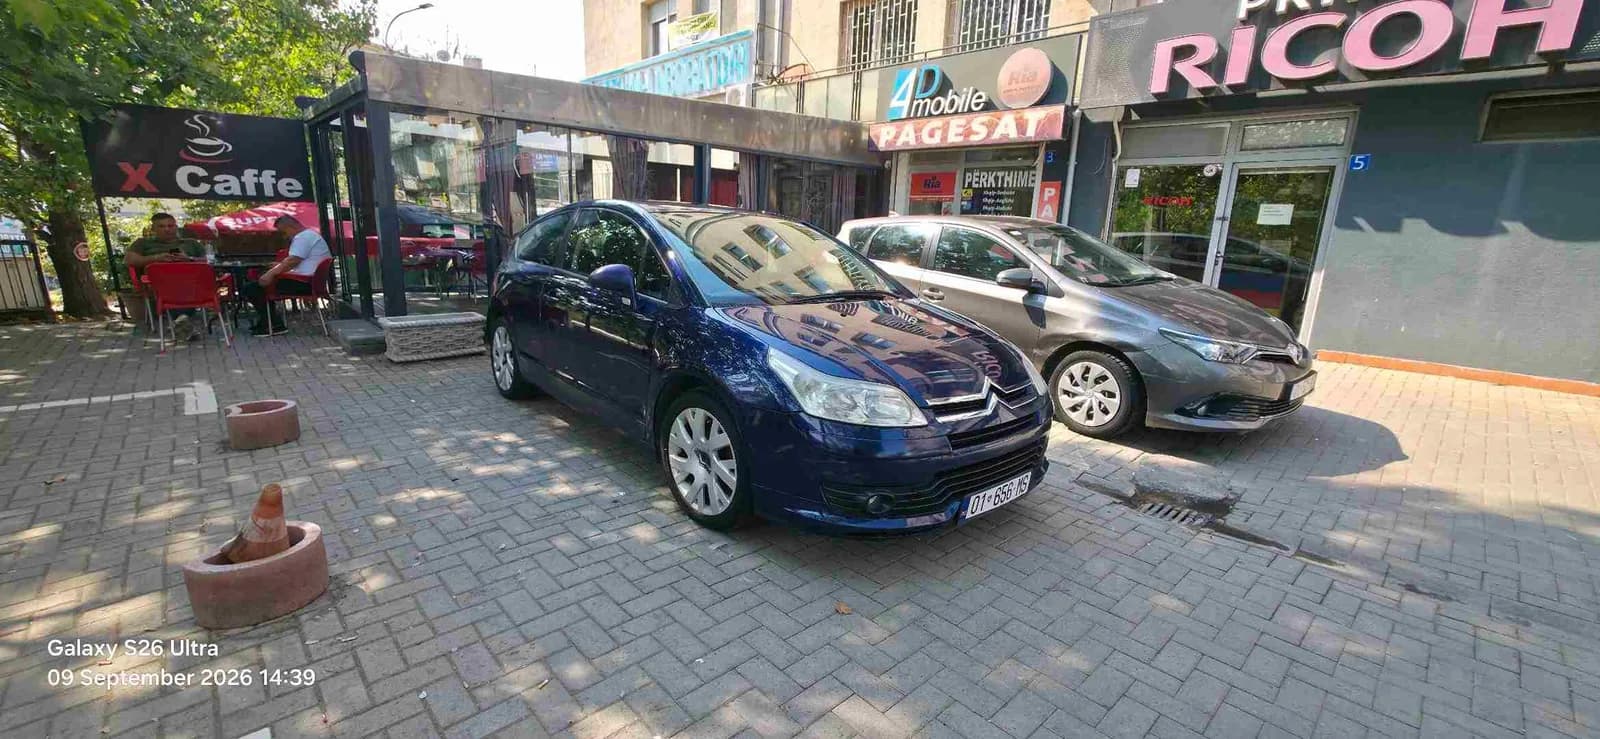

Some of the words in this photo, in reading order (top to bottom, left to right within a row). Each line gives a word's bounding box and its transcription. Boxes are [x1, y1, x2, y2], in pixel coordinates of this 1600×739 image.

[1149, 0, 1583, 95] RICOH
[911, 86, 986, 118] mobile
[878, 110, 1047, 148] PAGESAT
[1046, 152, 1054, 163] 3
[1352, 155, 1366, 170] 5
[118, 162, 160, 193] X
[175, 165, 303, 198] Caffe
[964, 169, 1036, 188] PËRKTHIME
